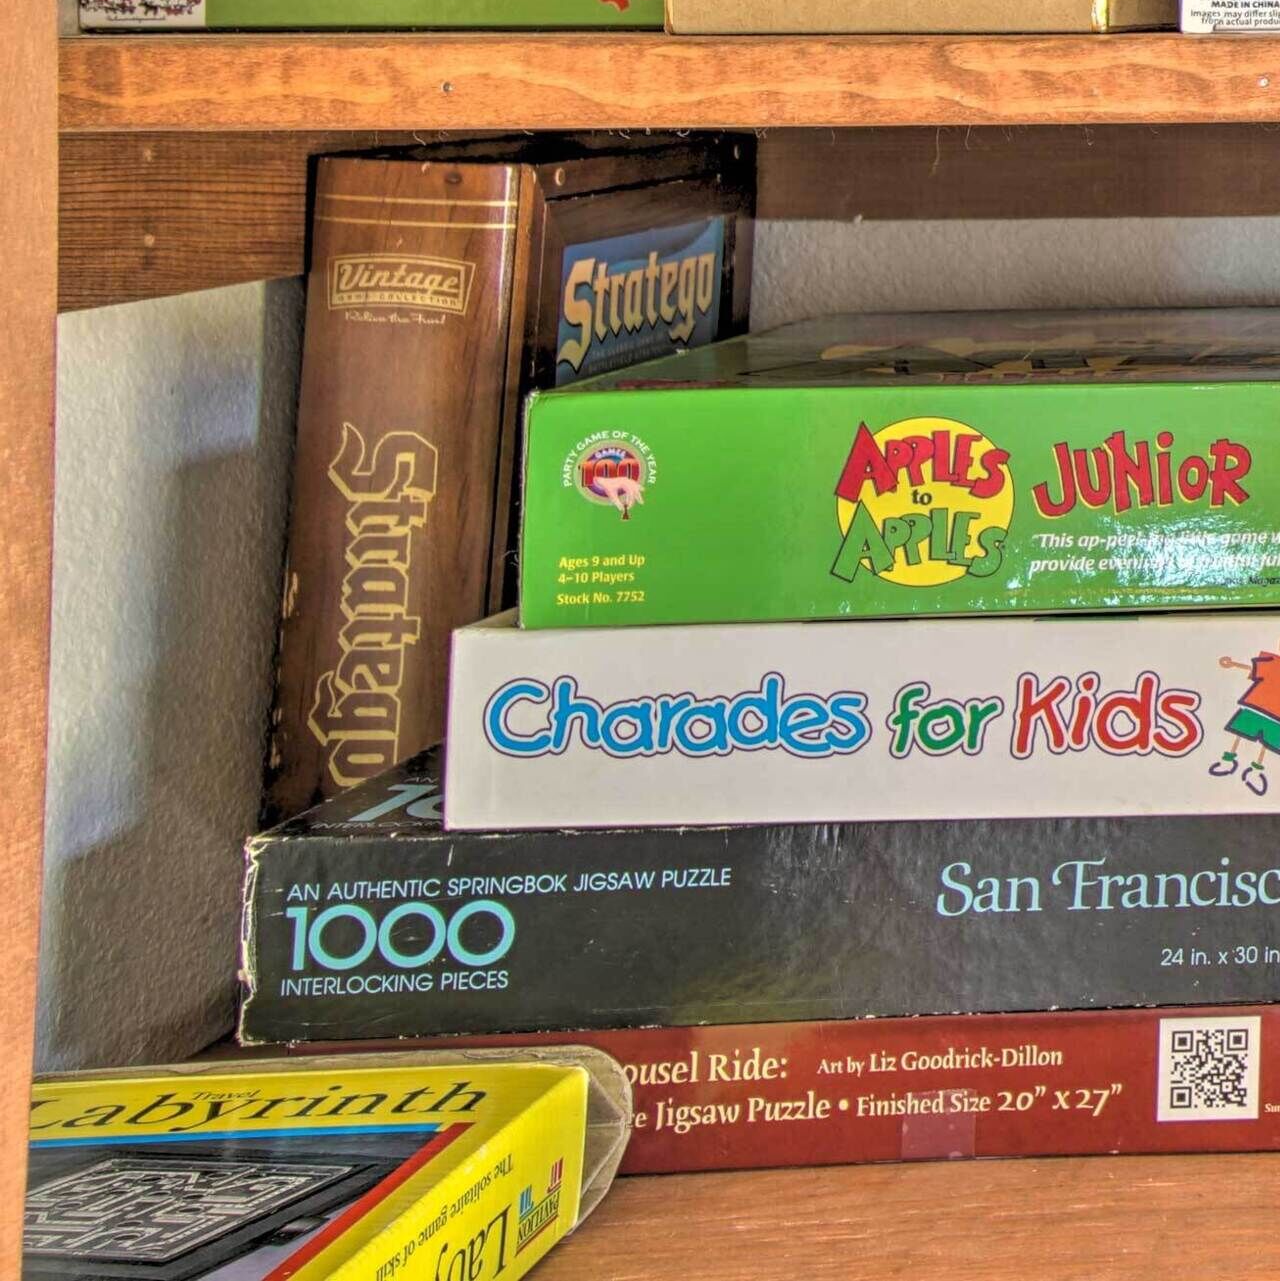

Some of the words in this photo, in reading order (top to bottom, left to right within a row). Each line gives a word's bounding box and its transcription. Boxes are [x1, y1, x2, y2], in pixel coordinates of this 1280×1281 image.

[338, 263, 460, 292] Vintage
[557, 250, 716, 373] Stratego
[835, 422, 1010, 502] APPLES
[912, 489, 932, 505] to
[829, 500, 1008, 583] APPLES
[308, 421, 438, 788] Stratego
[484, 672, 871, 760] Charades
[890, 681, 1002, 761] for
[1011, 671, 1205, 761] Kids
[287, 882, 320, 901] AN
[327, 878, 440, 900] AUTHENTIC
[447, 873, 567, 896] SPRINGBOK
[573, 870, 655, 891] JIGSAW
[662, 868, 732, 888] PUZZLE
[935, 863, 1044, 918] San
[286, 899, 516, 970] 1000
[280, 973, 432, 997] INTERLOCKING
[440, 970, 509, 990] PIECES
[708, 1052, 787, 1081] Ride:
[817, 1058, 843, 1075] Art
[846, 1058, 864, 1078] by
[869, 1051, 896, 1072] Liz
[900, 1046, 1063, 1071] Goodrick-Dillon
[31, 1082, 489, 1131] Labyrinth
[655, 1101, 739, 1133] Jigsaw
[746, 1095, 831, 1122] Puzzle
[517, 1198, 560, 1248] PAVILION
